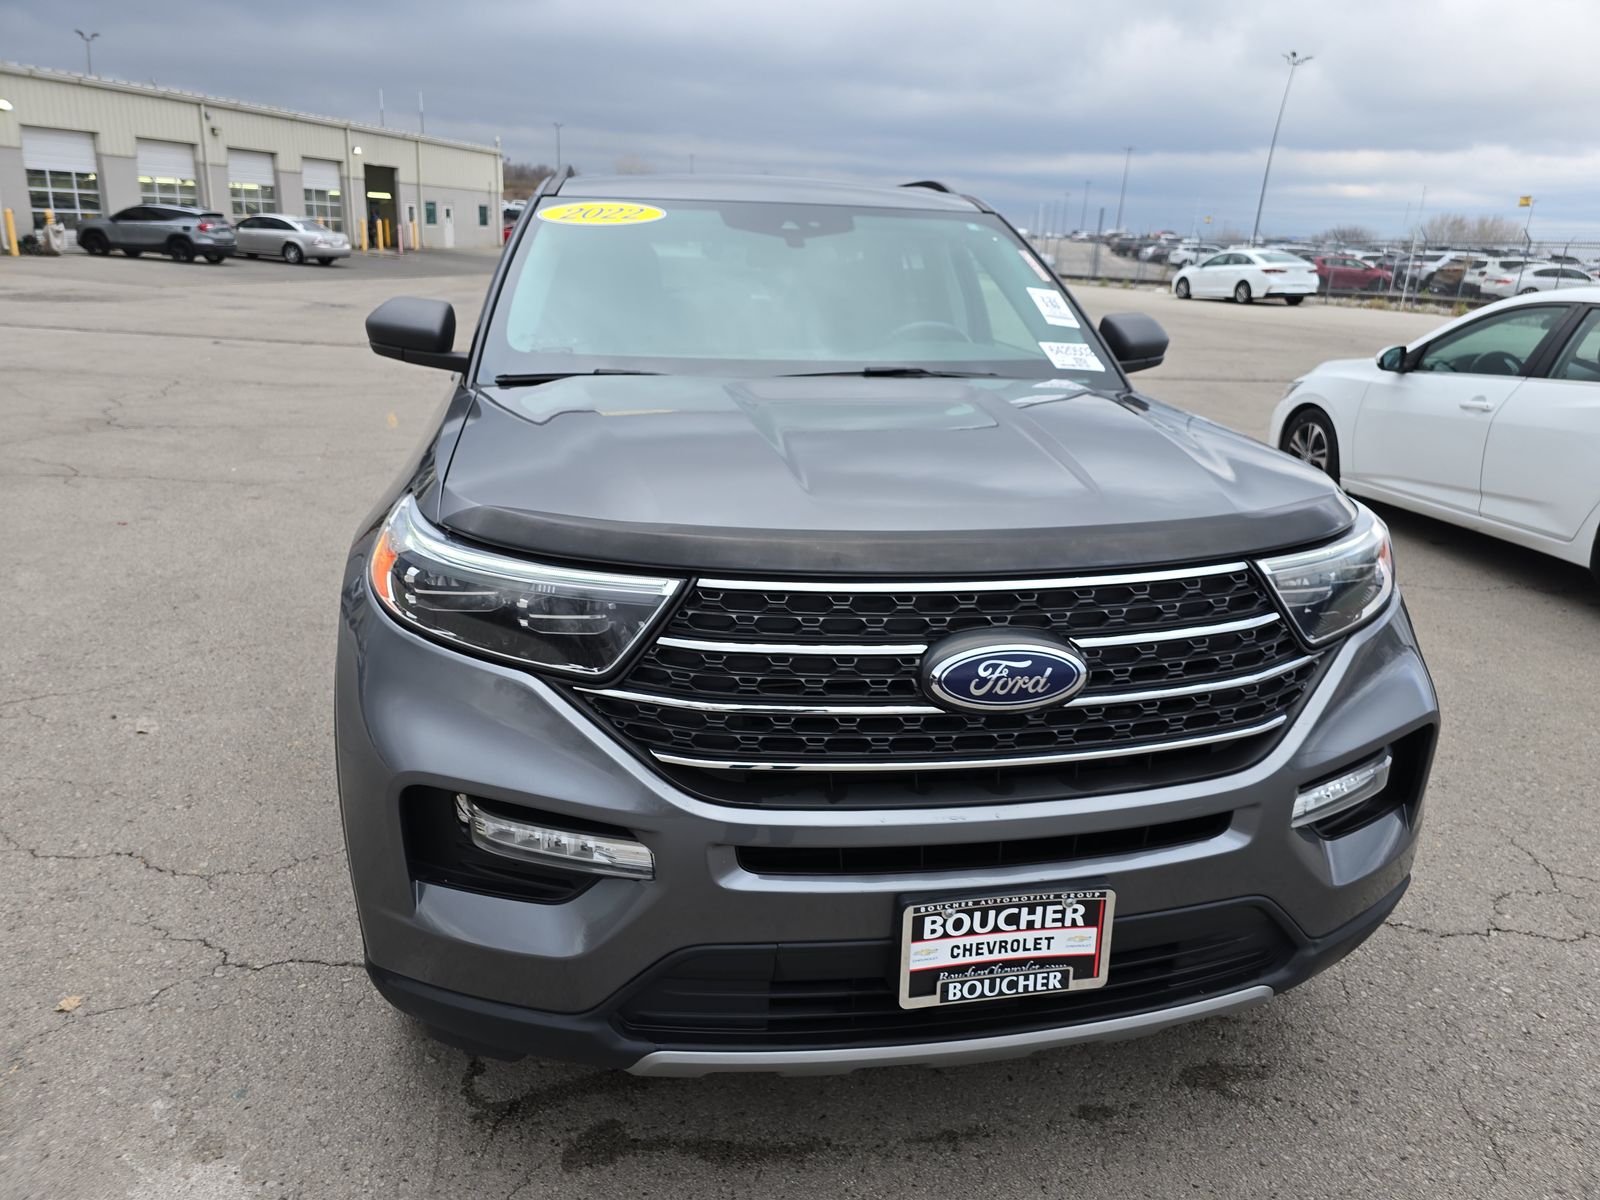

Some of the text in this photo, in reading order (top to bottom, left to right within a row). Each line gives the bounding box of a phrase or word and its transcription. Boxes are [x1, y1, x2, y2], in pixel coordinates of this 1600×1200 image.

[560, 207, 645, 219] 2022
[969, 660, 1052, 696] Ford
[920, 891, 1101, 913] BOUCHER AUTOMOTIVE GROUP
[923, 903, 1086, 940] BOUCHER
[950, 936, 1055, 959] CHEVROLET
[947, 971, 1062, 1001] BOUCHER
